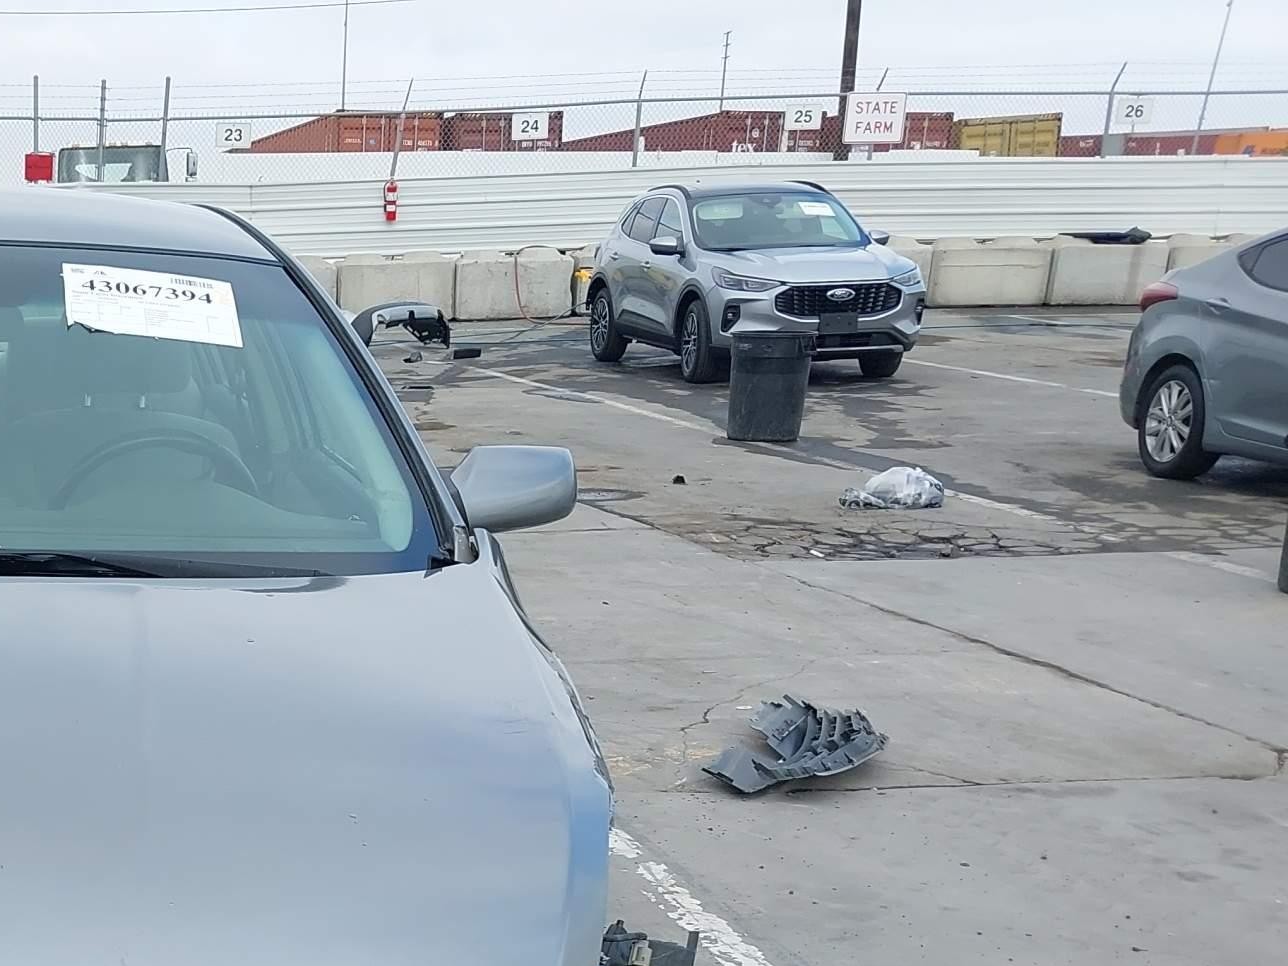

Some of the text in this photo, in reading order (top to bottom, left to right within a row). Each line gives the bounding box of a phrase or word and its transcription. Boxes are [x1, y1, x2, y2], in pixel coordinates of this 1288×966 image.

[855, 101, 898, 115] STATE
[1124, 104, 1145, 119] 26
[793, 109, 813, 124] 25
[520, 119, 540, 134] 24
[855, 121, 894, 135] FARM
[223, 128, 243, 142] 23
[81, 279, 213, 304] 43067394
